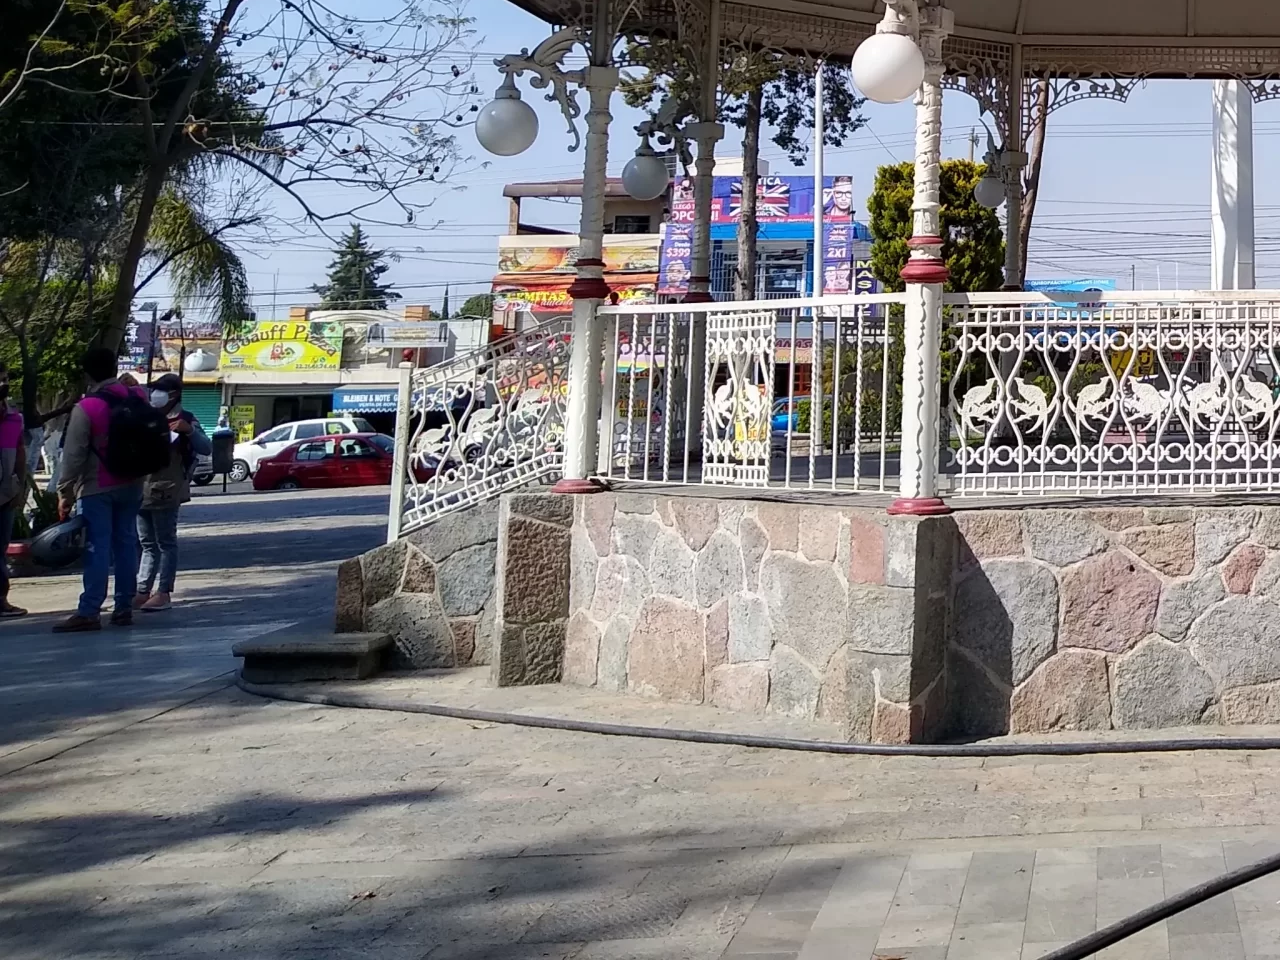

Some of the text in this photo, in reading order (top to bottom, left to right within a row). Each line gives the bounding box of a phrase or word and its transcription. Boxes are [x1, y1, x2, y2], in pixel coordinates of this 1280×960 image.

[666, 248, 691, 257] $399
[223, 324, 337, 357] Guauff Pizza
